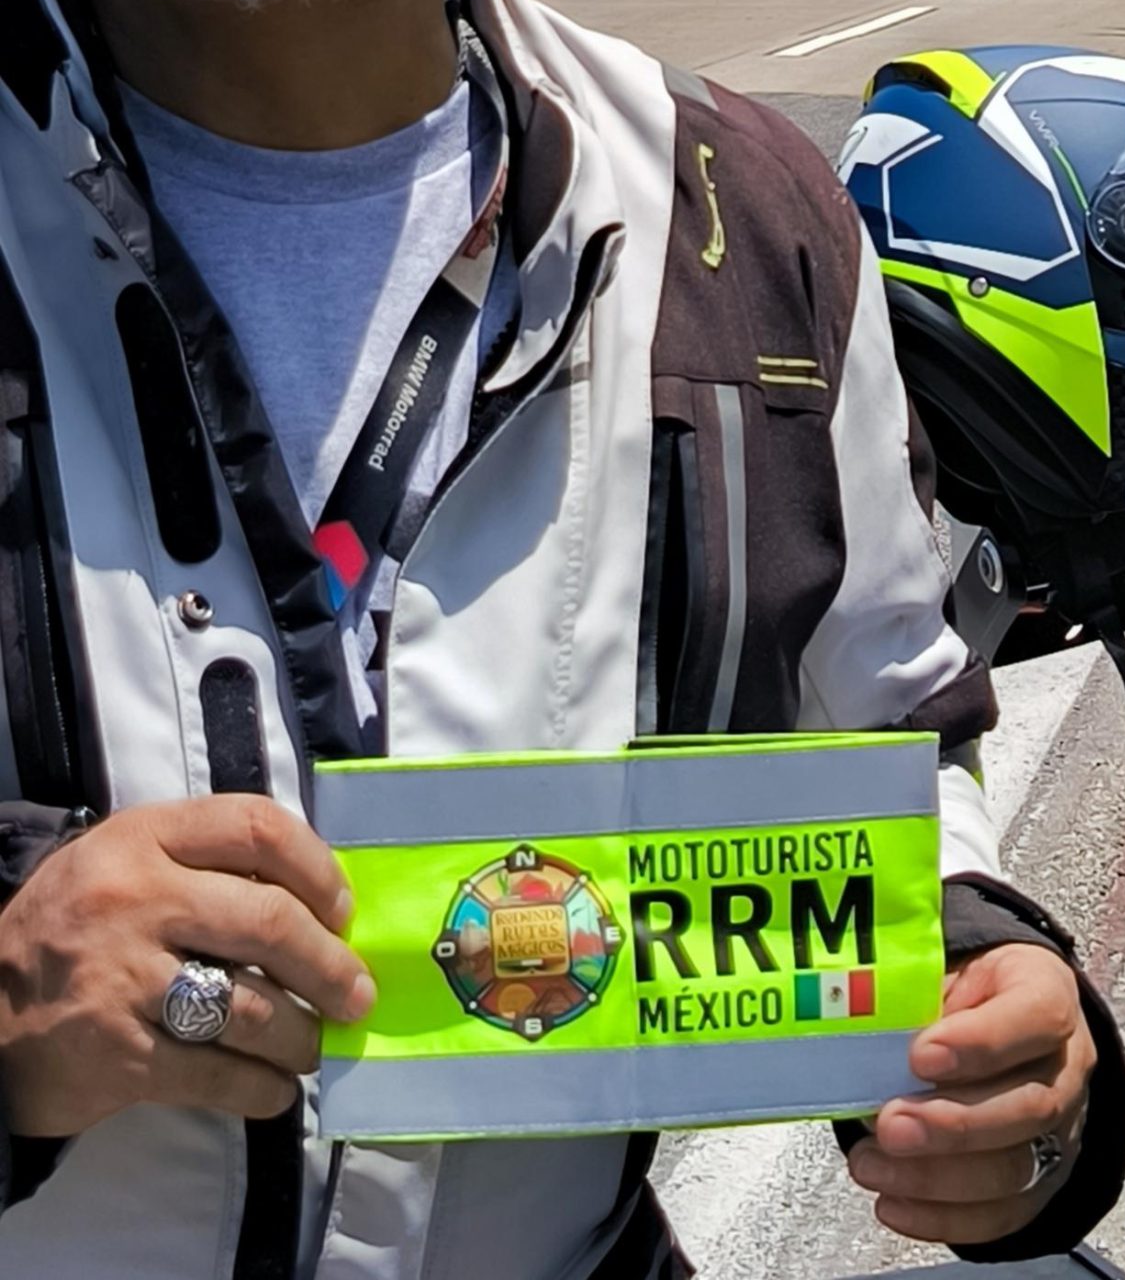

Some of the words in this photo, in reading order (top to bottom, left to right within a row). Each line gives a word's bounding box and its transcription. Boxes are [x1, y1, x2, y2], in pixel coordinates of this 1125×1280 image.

[407, 334, 438, 388] BMW
[369, 383, 419, 472] Motorrad
[515, 850, 536, 867] N
[629, 828, 874, 884] MOTOTURISTA
[605, 926, 622, 943] E
[629, 875, 876, 982] RRM
[639, 986, 783, 1034] MÉXICO
